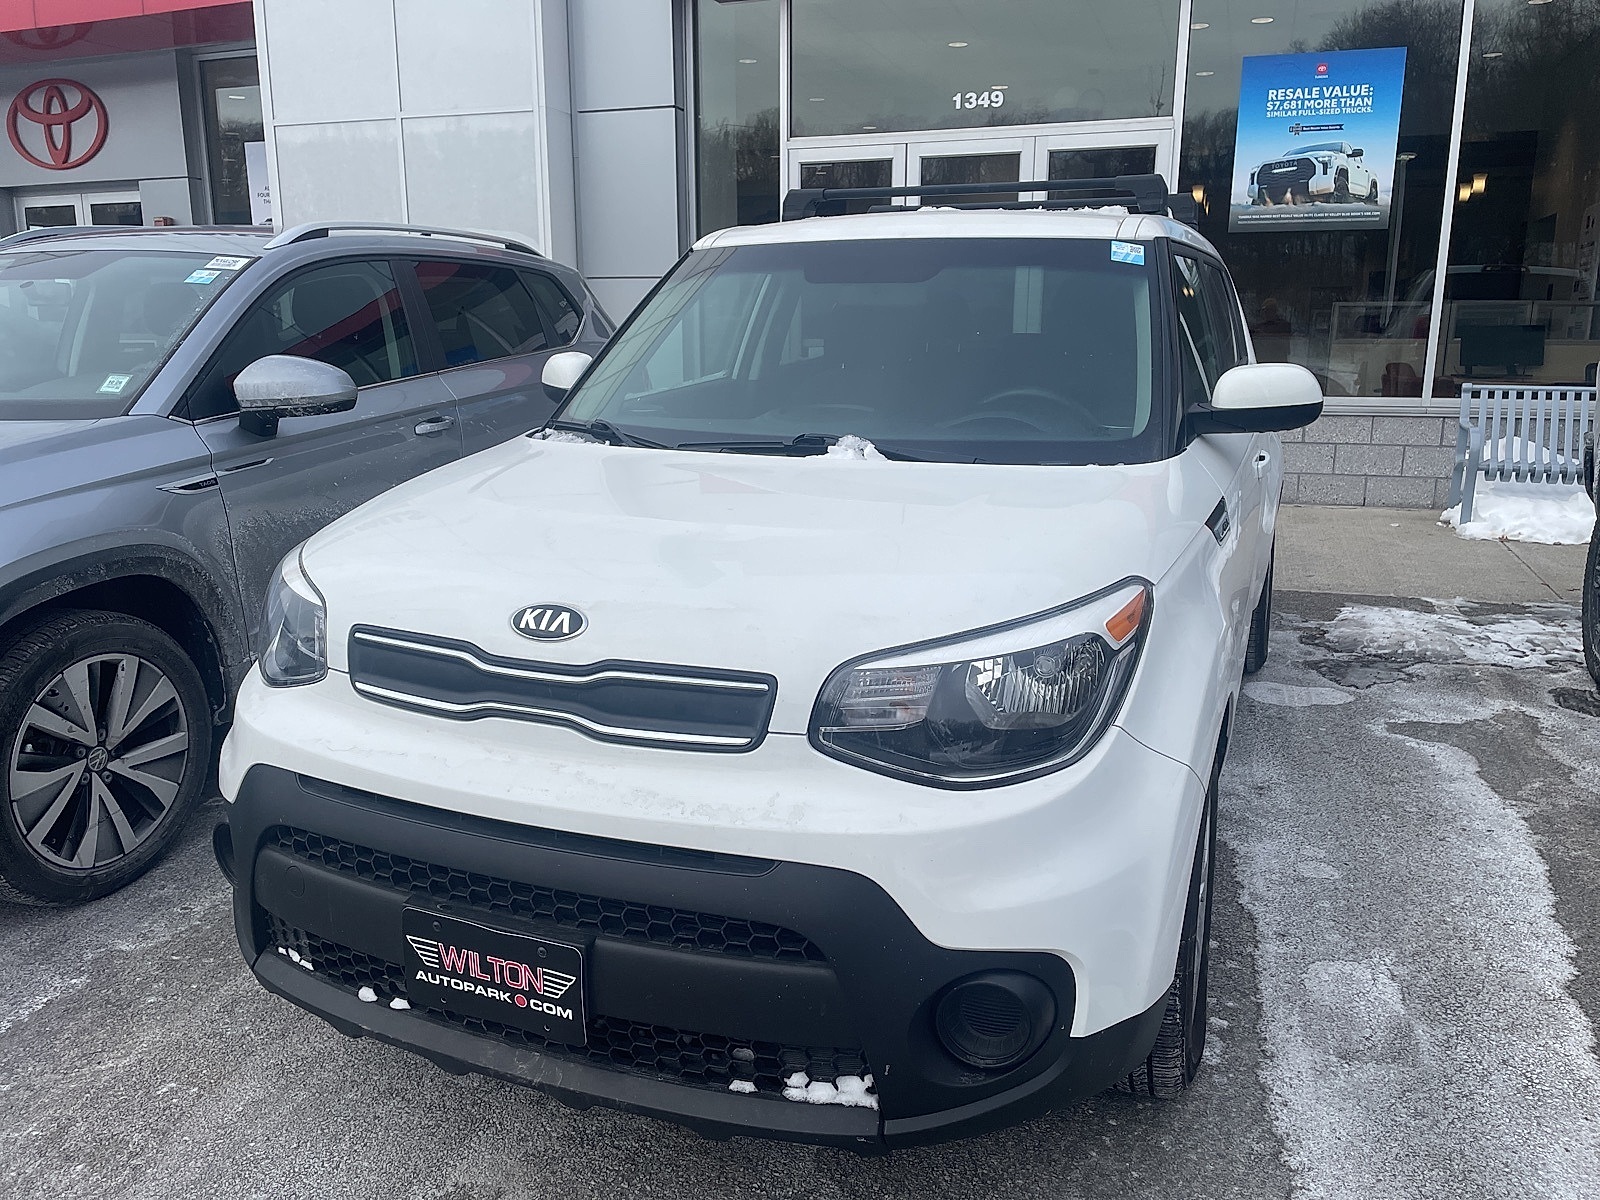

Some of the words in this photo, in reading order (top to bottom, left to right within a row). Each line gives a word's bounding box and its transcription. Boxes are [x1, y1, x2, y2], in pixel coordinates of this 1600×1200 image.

[1268, 86, 1320, 101] RESALE
[1323, 84, 1374, 98] VALUE:
[952, 91, 1004, 110] 1349
[1266, 99, 1304, 111] $7,681
[1304, 98, 1338, 109] MORE
[1340, 97, 1373, 107] THAN
[1266, 109, 1298, 118] SIMILAR
[1298, 107, 1341, 116] FULL-SIZED
[1342, 106, 1374, 114] TRUCKS.
[1271, 160, 1298, 169] TOYOTA
[198, 479, 216, 487] TAOS
[519, 608, 571, 634] KIA
[438, 943, 544, 995] WILTON
